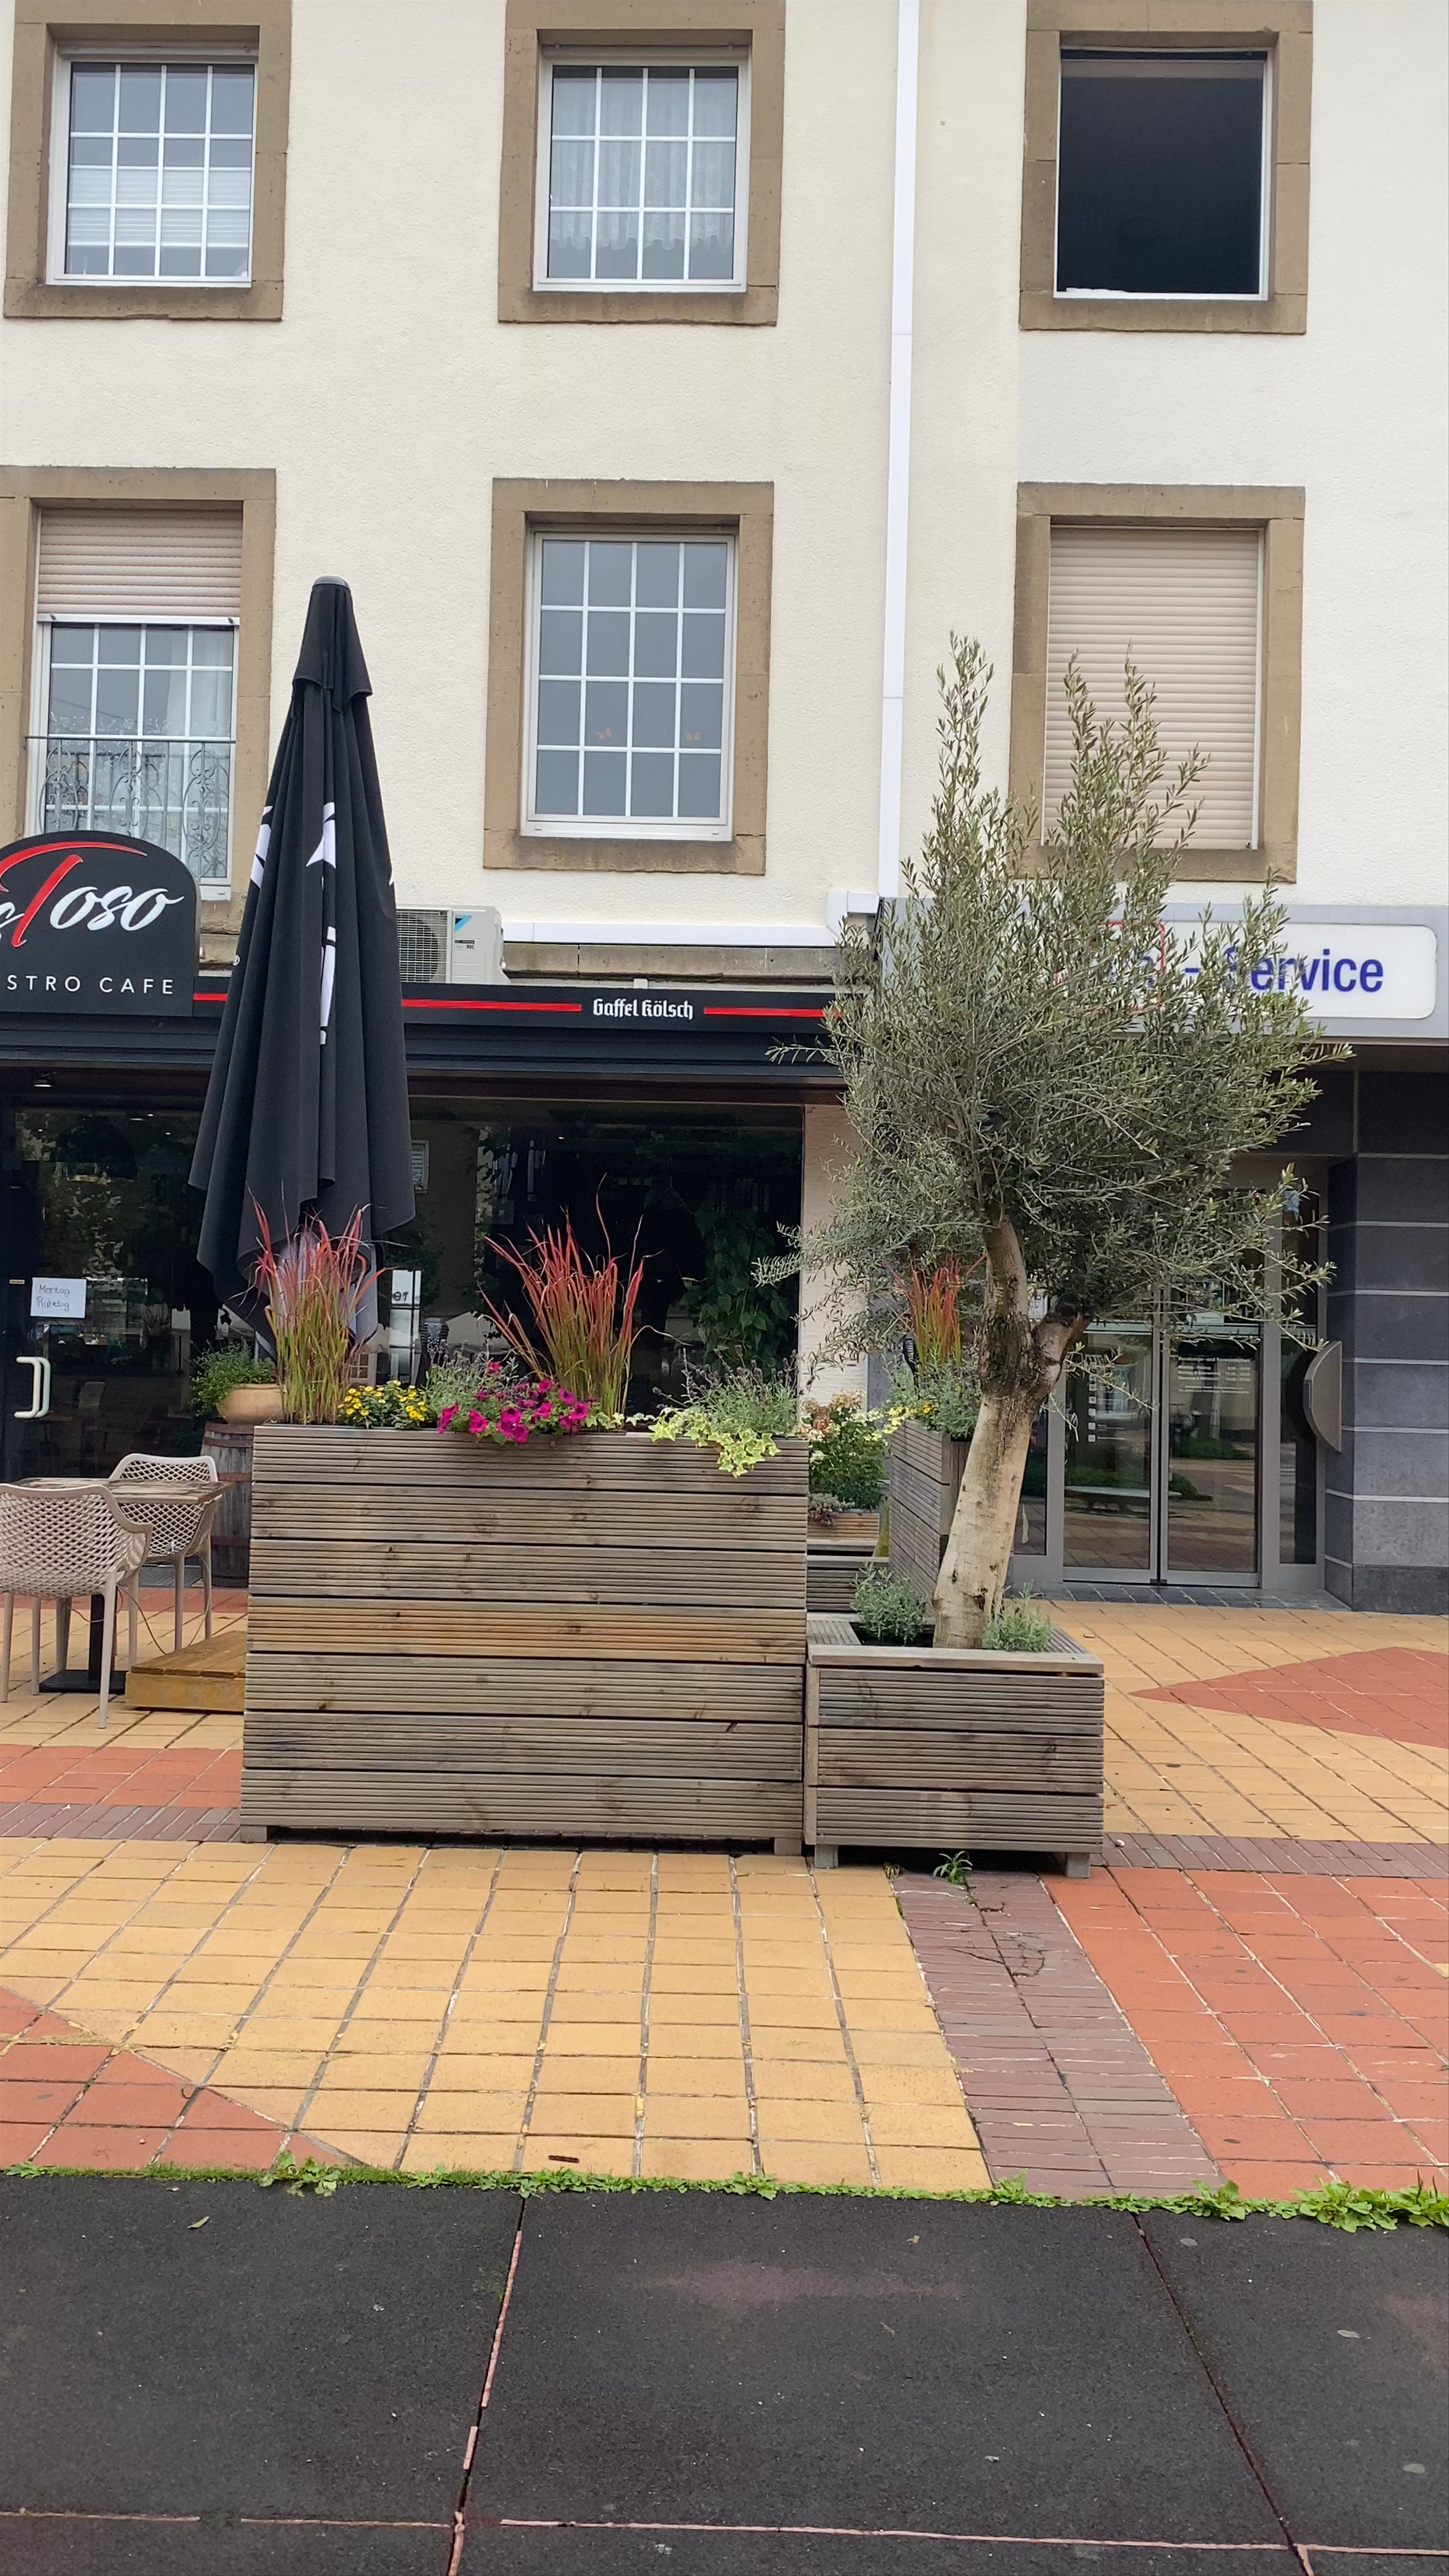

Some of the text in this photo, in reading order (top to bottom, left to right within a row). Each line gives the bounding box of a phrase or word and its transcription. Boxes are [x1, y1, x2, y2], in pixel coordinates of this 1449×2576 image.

[99, 977, 173, 994] CAFE
[593, 998, 693, 1020] Gaffel Kölsch
[39, 1284, 70, 1297] Montag
